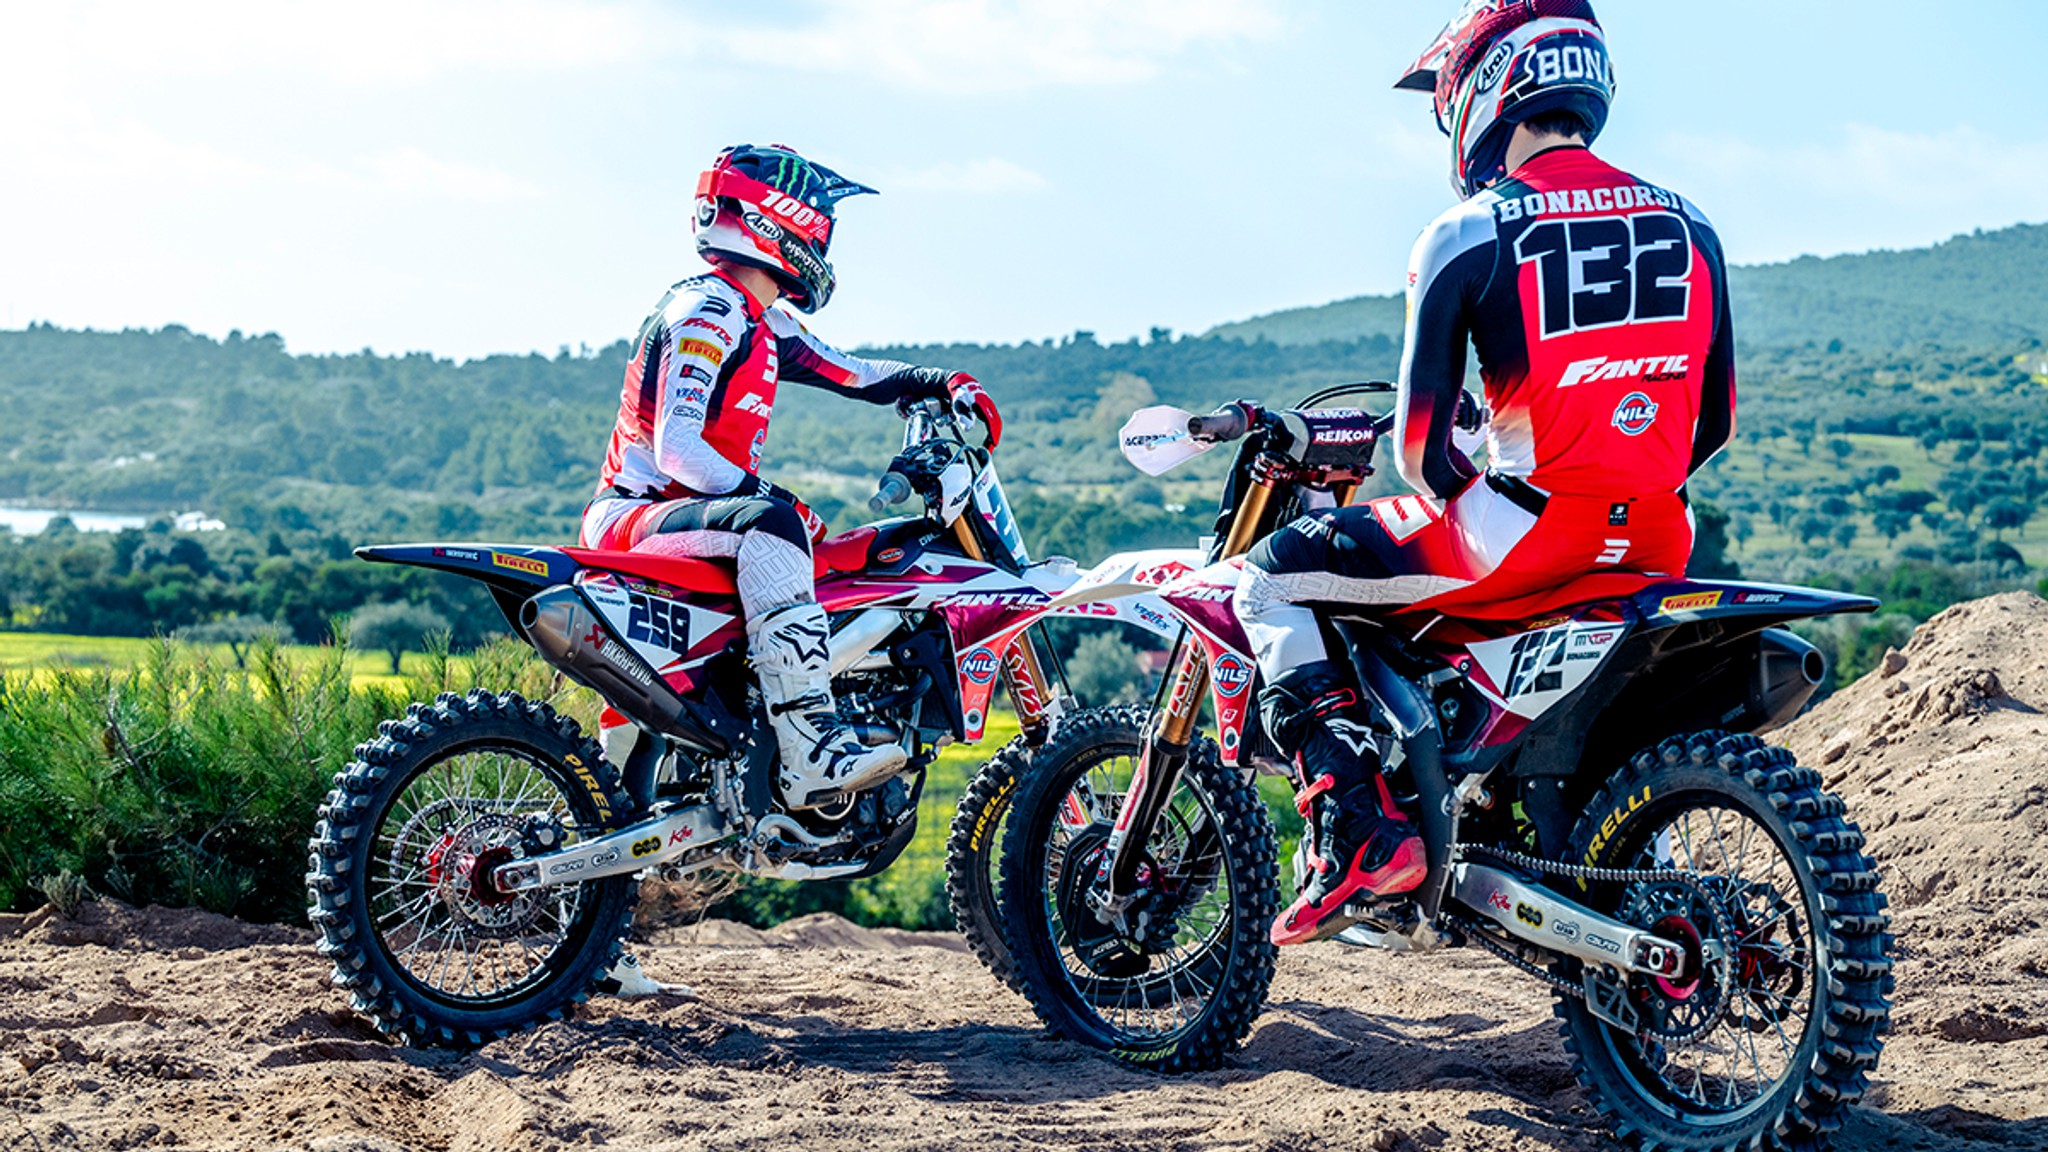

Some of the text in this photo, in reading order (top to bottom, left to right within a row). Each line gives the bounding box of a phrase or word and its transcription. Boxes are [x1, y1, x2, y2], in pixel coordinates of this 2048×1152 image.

[1480, 46, 1508, 93] Arai
[760, 189, 830, 240] 100%
[1497, 185, 1685, 222] BONACORSI
[750, 211, 780, 240] Arai
[1513, 210, 1693, 341] 132
[1556, 354, 1690, 389] FANTIC
[1640, 371, 1687, 384] RACING
[1615, 404, 1657, 425] NILS
[495, 553, 545, 575] PIRELLI
[1663, 593, 1719, 610] PIRELLI
[626, 592, 690, 656] 259
[961, 659, 998, 674] NILS
[1212, 667, 1251, 683] NILS
[970, 775, 1015, 852] PIRELLI
